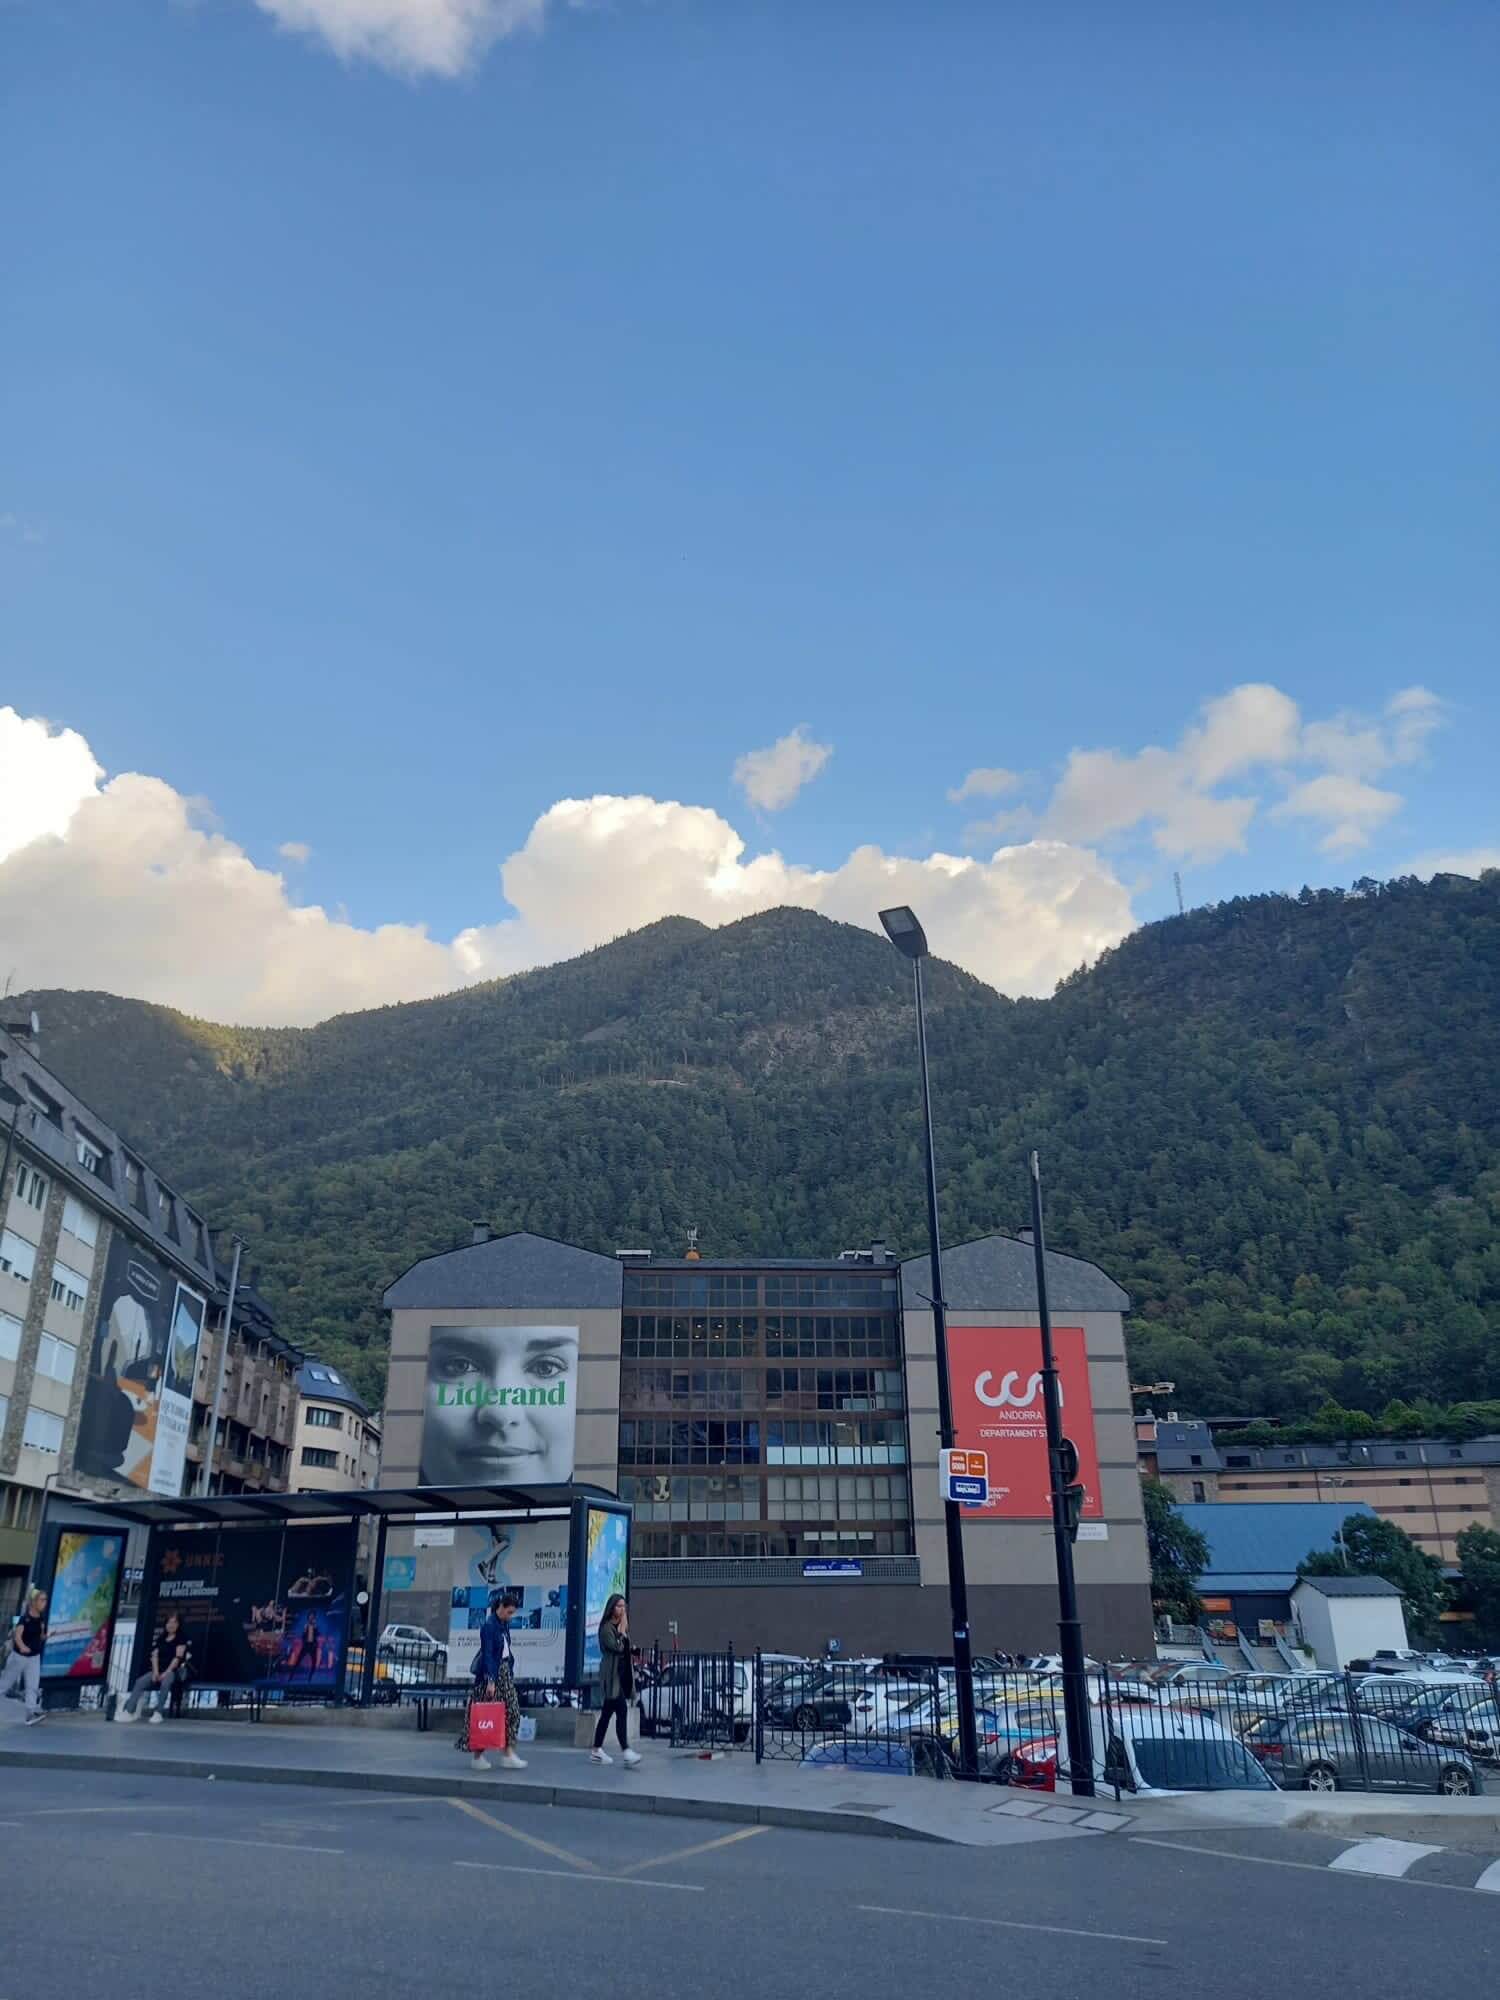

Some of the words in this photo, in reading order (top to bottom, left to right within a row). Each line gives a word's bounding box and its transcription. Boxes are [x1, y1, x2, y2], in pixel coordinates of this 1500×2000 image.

[436, 1381, 566, 1407] Liderand
[999, 1410, 1043, 1420] ANDORRA
[980, 1429, 1037, 1438] DEPARTAMENT
